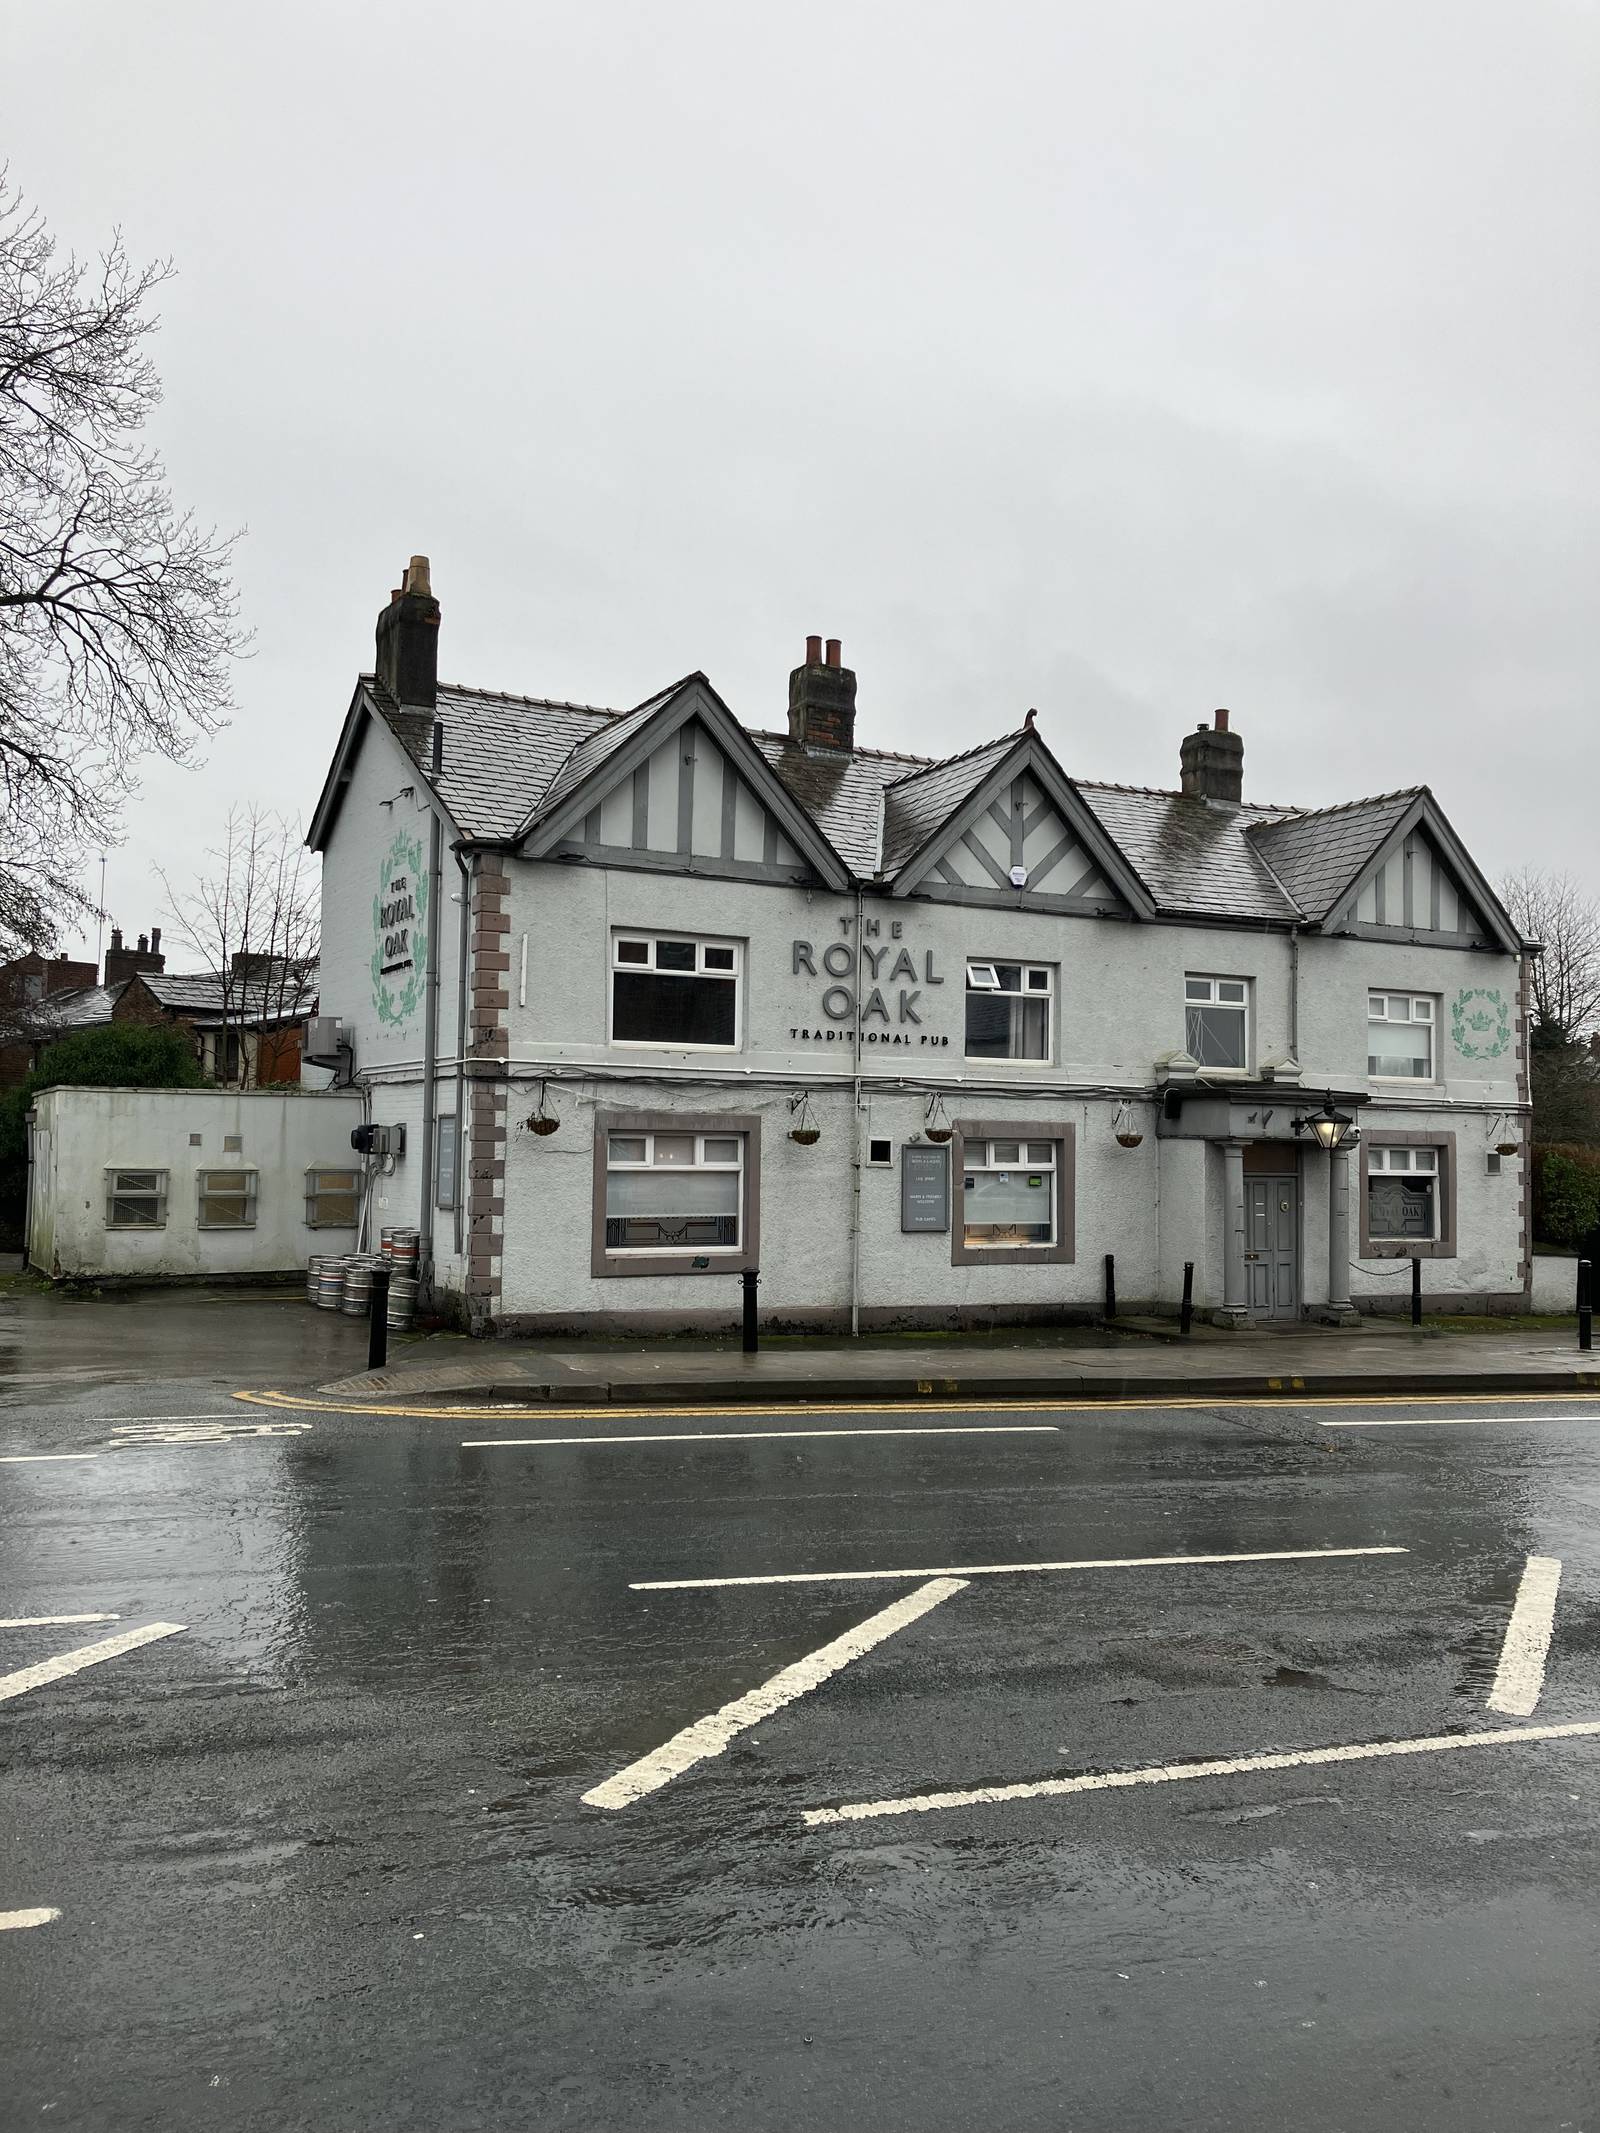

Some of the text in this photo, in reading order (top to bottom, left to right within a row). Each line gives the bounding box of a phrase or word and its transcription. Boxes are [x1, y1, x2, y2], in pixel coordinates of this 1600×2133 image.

[390, 877, 407, 893] THE
[380, 895, 415, 928] ROYAL
[840, 916, 903, 939] THE
[385, 928, 408, 957] OAK
[792, 940, 945, 984] ROYAL
[822, 985, 923, 1024] OAK
[790, 1028, 949, 1047] TRADITIONAL PUB
[1402, 1206, 1420, 1217] OAK
